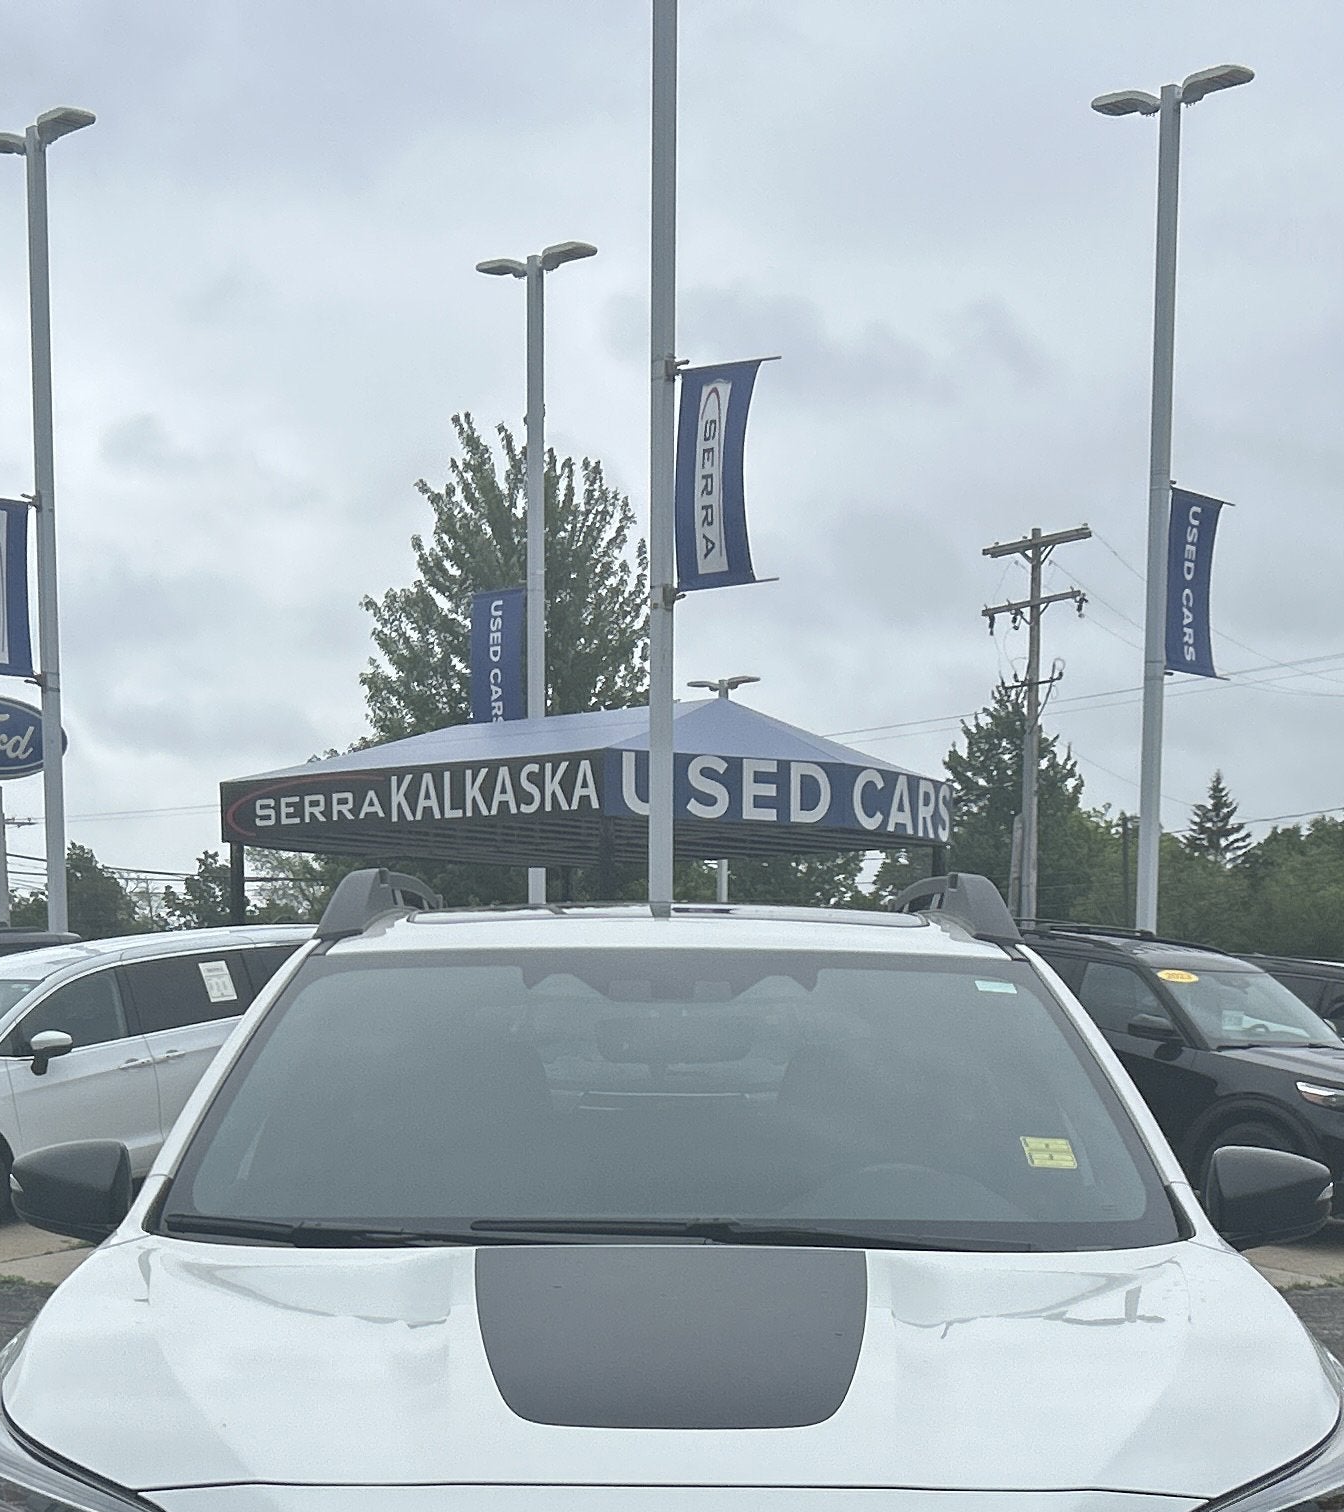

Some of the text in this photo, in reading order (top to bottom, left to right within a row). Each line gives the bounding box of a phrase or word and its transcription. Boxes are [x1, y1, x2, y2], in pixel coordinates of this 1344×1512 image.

[701, 418, 717, 560] SERRA
[1181, 505, 1202, 662] USED CARS
[489, 600, 503, 662] USED
[255, 759, 600, 827] SERRA KALKASKA
[853, 768, 952, 843] CARS
